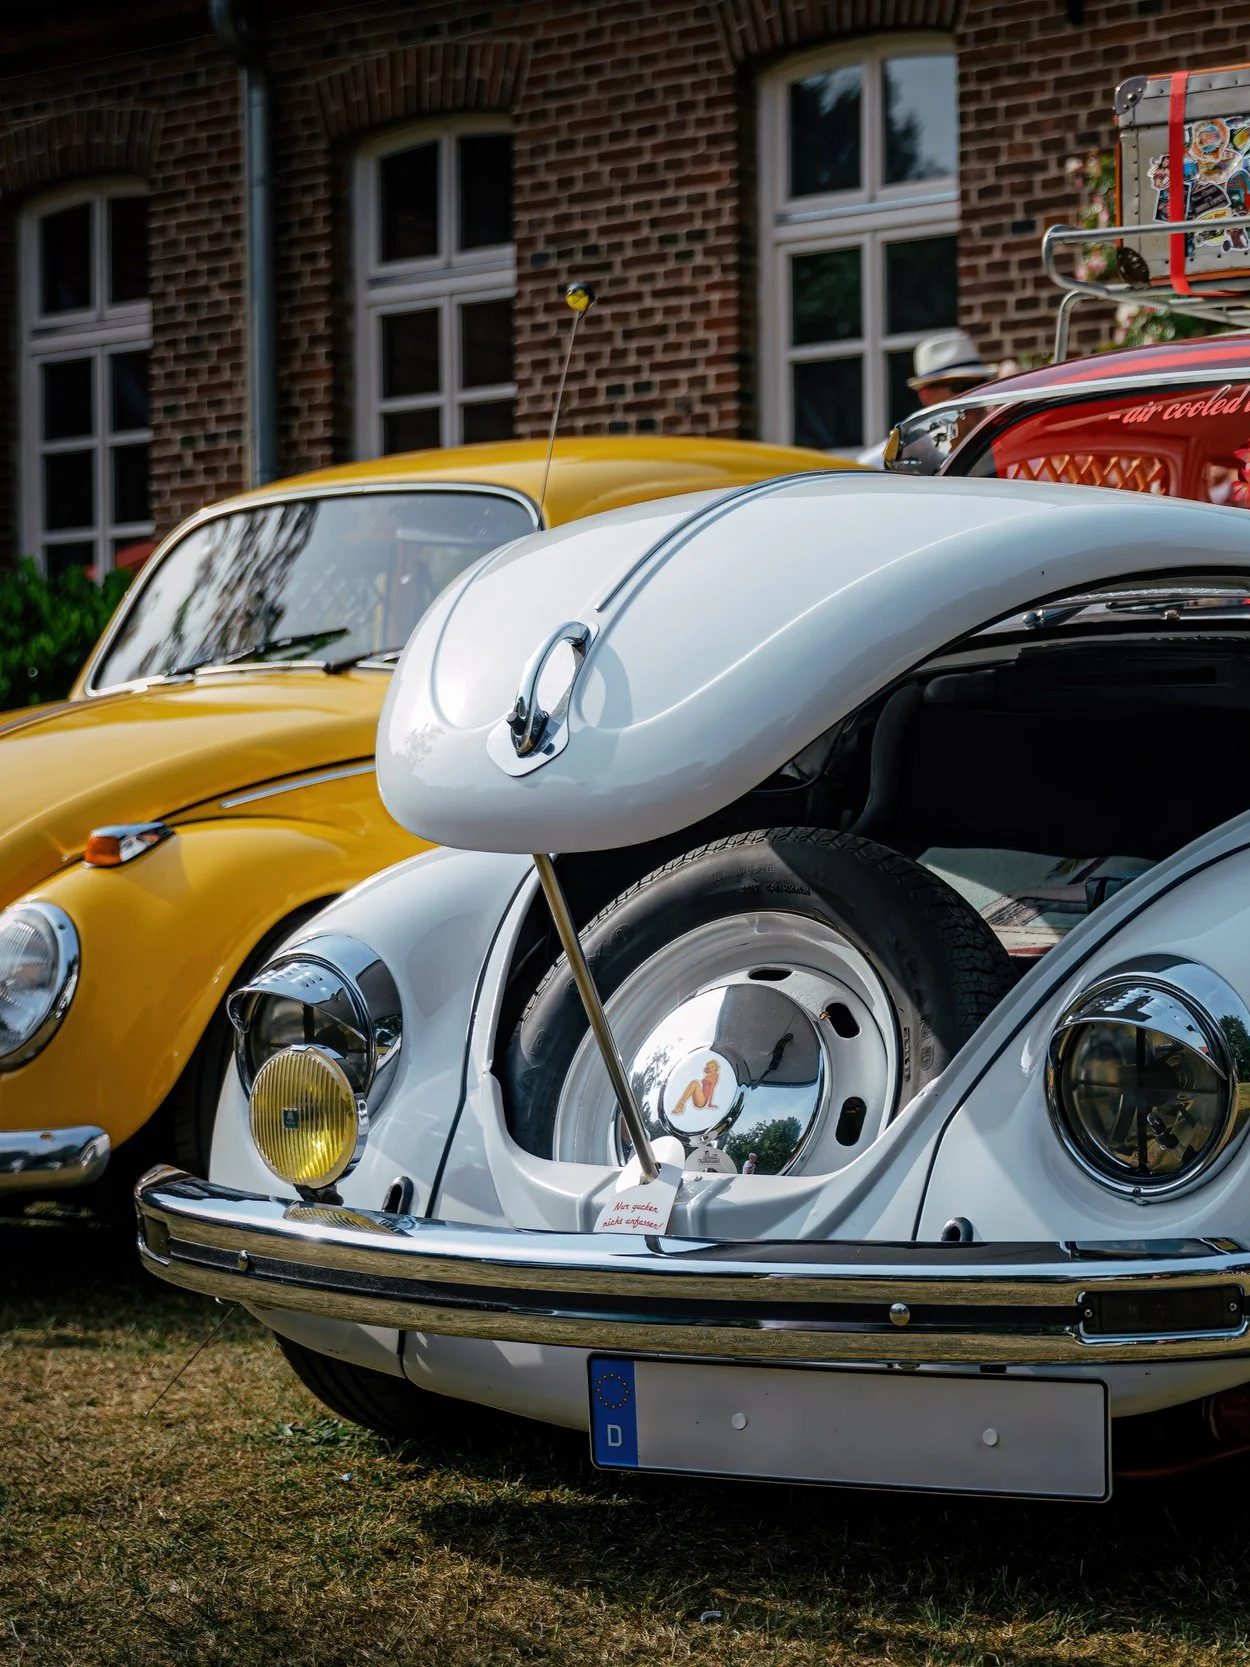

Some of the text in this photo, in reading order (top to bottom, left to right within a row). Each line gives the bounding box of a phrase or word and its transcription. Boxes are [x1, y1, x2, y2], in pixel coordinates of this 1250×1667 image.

[1121, 401, 1164, 425] air
[613, 1201, 630, 1212] Nur
[602, 1215, 664, 1230] nicht anfassen!
[607, 1424, 622, 1447] D
